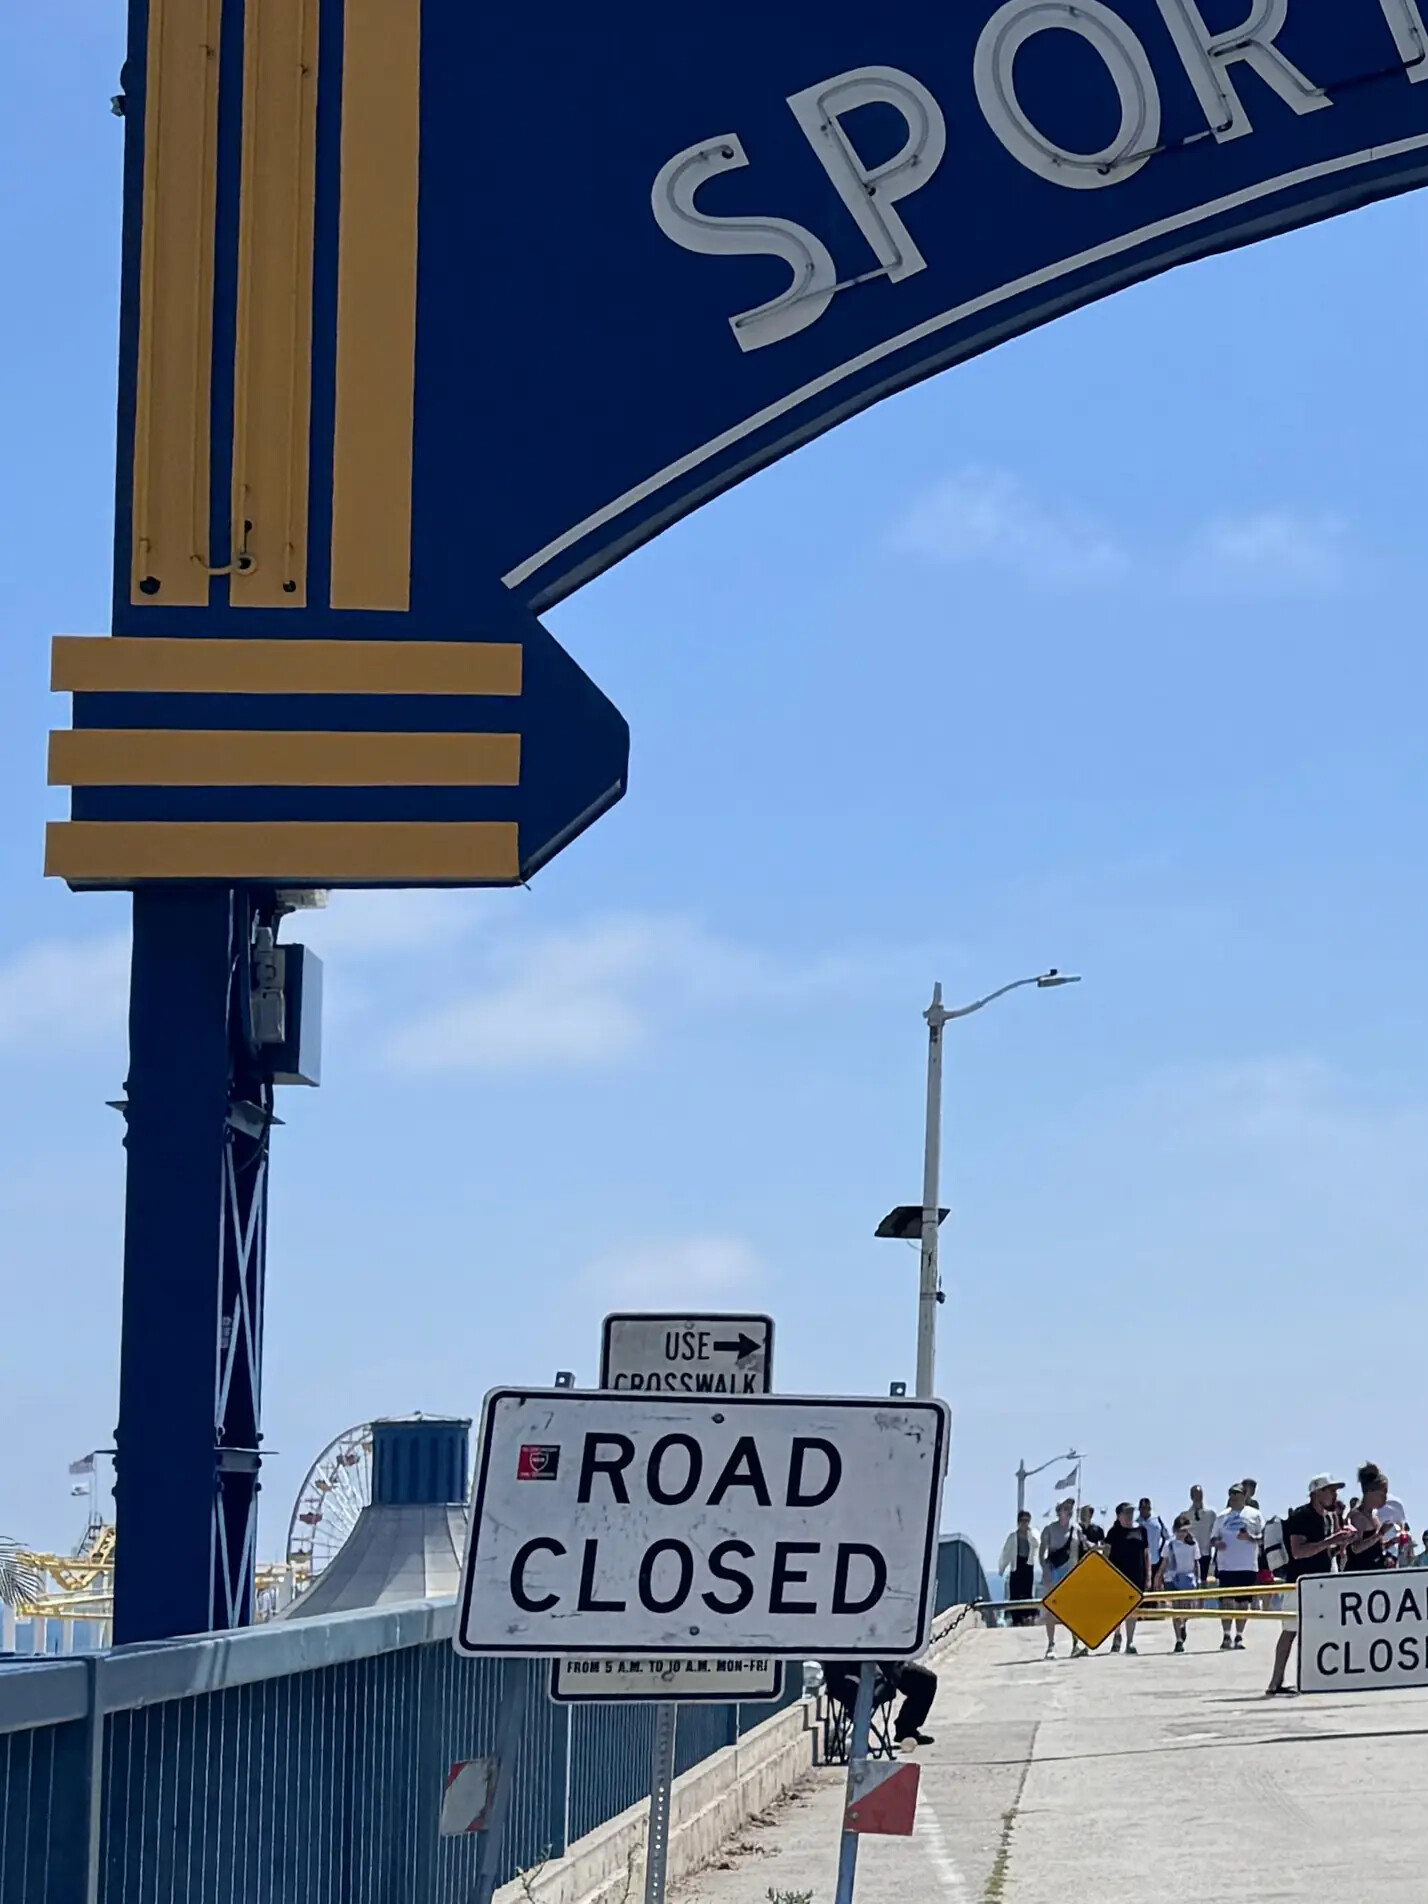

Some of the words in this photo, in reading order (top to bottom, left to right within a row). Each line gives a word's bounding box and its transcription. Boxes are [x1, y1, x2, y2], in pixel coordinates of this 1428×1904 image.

[665, 1332, 711, 1360] USE
[614, 1372, 757, 1394] CROSSWALK
[577, 1432, 843, 1507] ROAD
[509, 1536, 888, 1614] CLOSED
[567, 1661, 600, 1673] FROM
[605, 1661, 613, 1673] 5
[618, 1660, 643, 1673] A.M.
[650, 1660, 663, 1672] TO
[668, 1660, 681, 1673] 10
[685, 1660, 711, 1672] A.M.
[716, 1659, 768, 1672] MON-FRI
